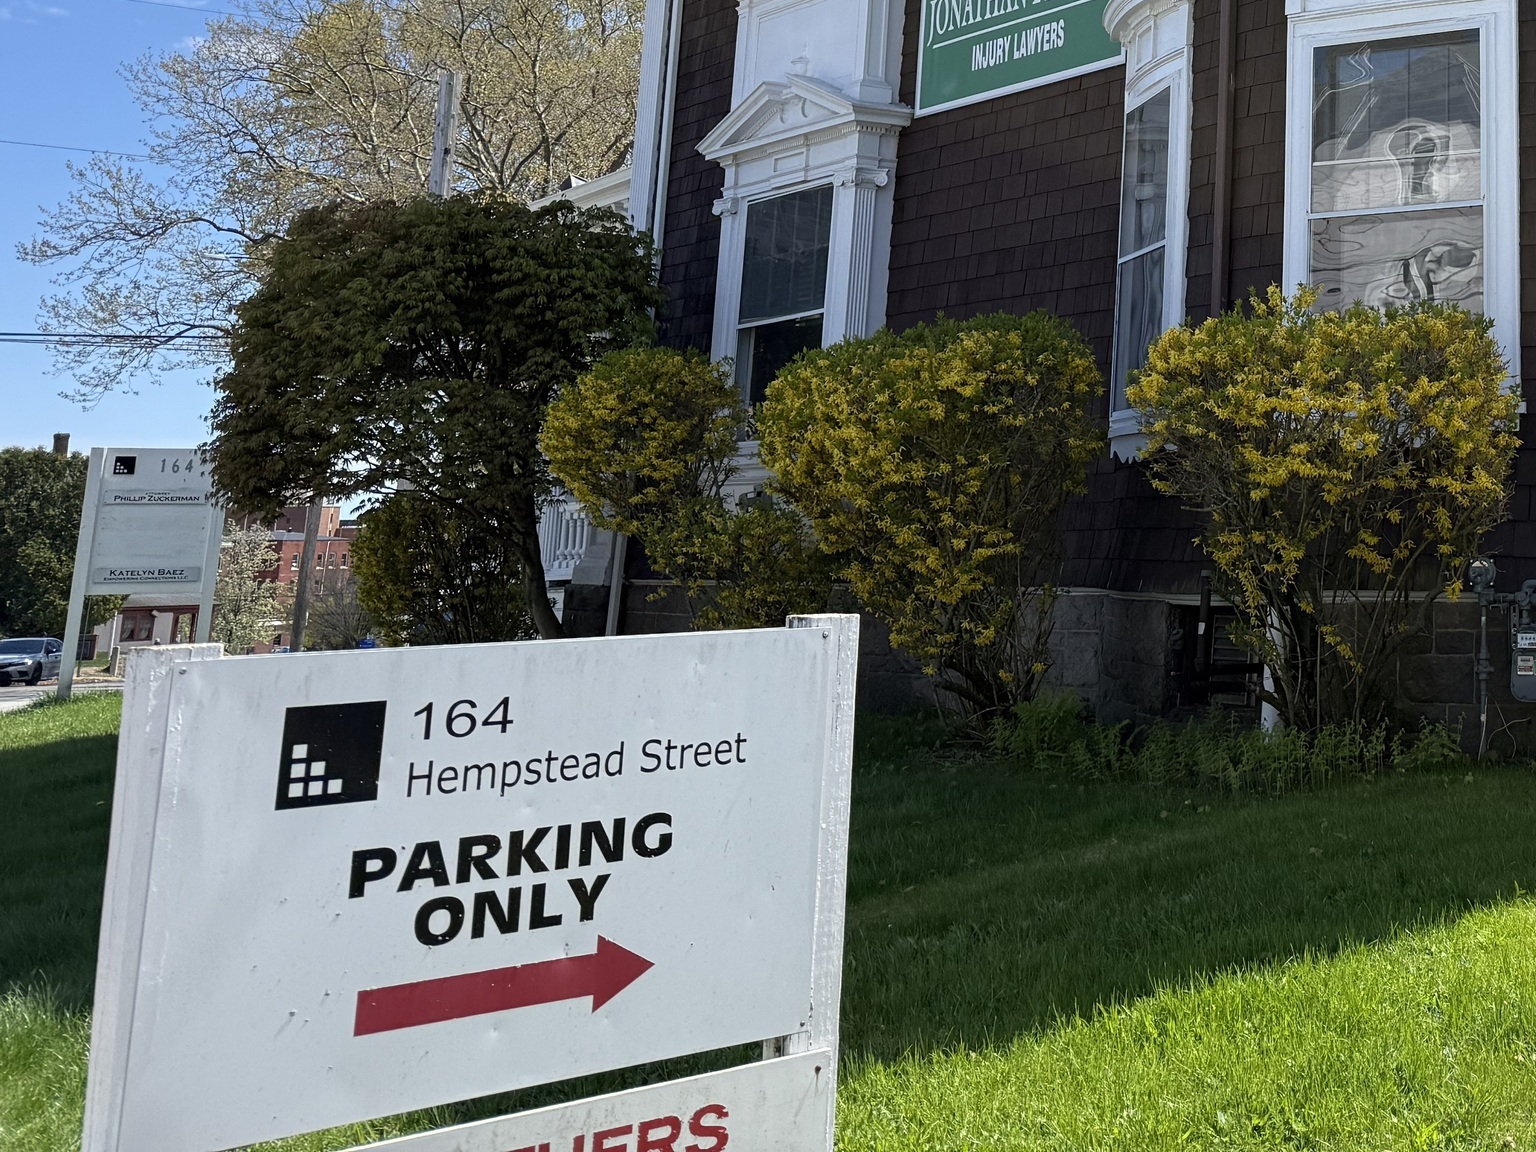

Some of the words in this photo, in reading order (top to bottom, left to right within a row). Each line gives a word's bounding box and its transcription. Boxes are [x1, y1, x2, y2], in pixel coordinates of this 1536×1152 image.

[971, 35, 1012, 72] INJURY
[1013, 18, 1065, 59] LAWYERS
[160, 458, 194, 474] 164
[109, 569, 155, 577] KATELYN
[157, 568, 185, 576] BAEZ
[413, 696, 514, 740] 164
[406, 741, 625, 798] Hempstead
[640, 732, 748, 773] Street
[348, 812, 673, 898] PARKING
[414, 874, 611, 946] ONLY
